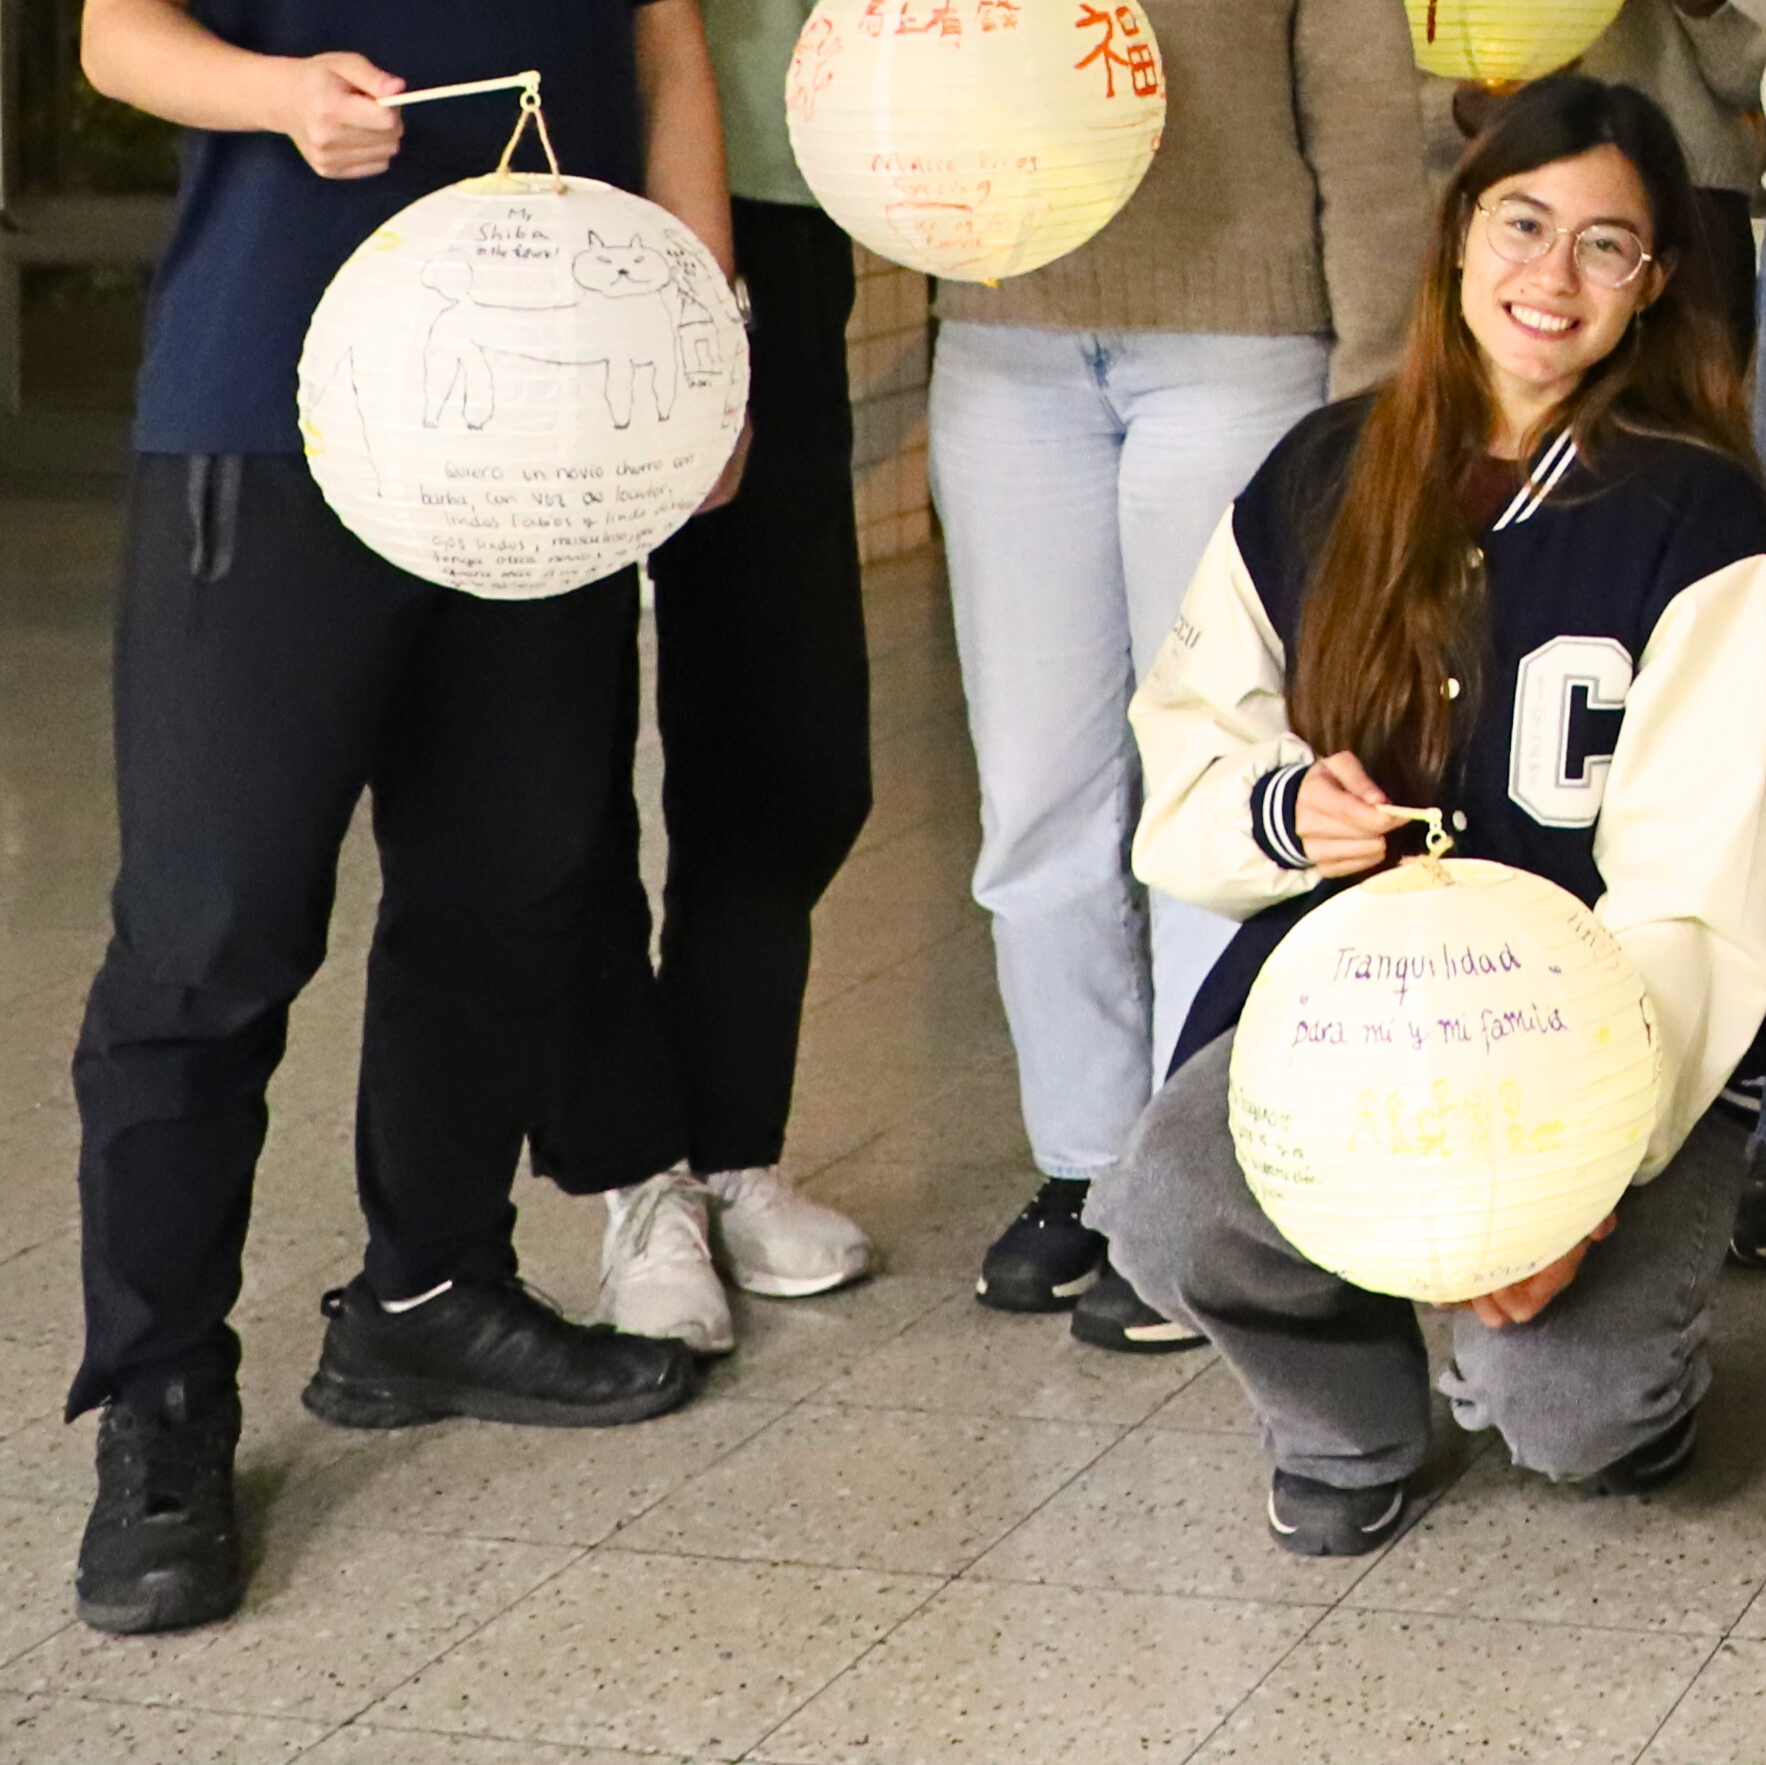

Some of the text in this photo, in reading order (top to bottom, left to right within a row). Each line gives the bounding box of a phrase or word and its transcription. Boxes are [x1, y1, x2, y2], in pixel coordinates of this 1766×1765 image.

[475, 222, 550, 242] Shiba
[1508, 635, 1635, 829] C
[1332, 941, 1522, 1007] Tranquilidad
[1291, 1019, 1347, 1048] para
[1407, 1021, 1427, 1051] y
